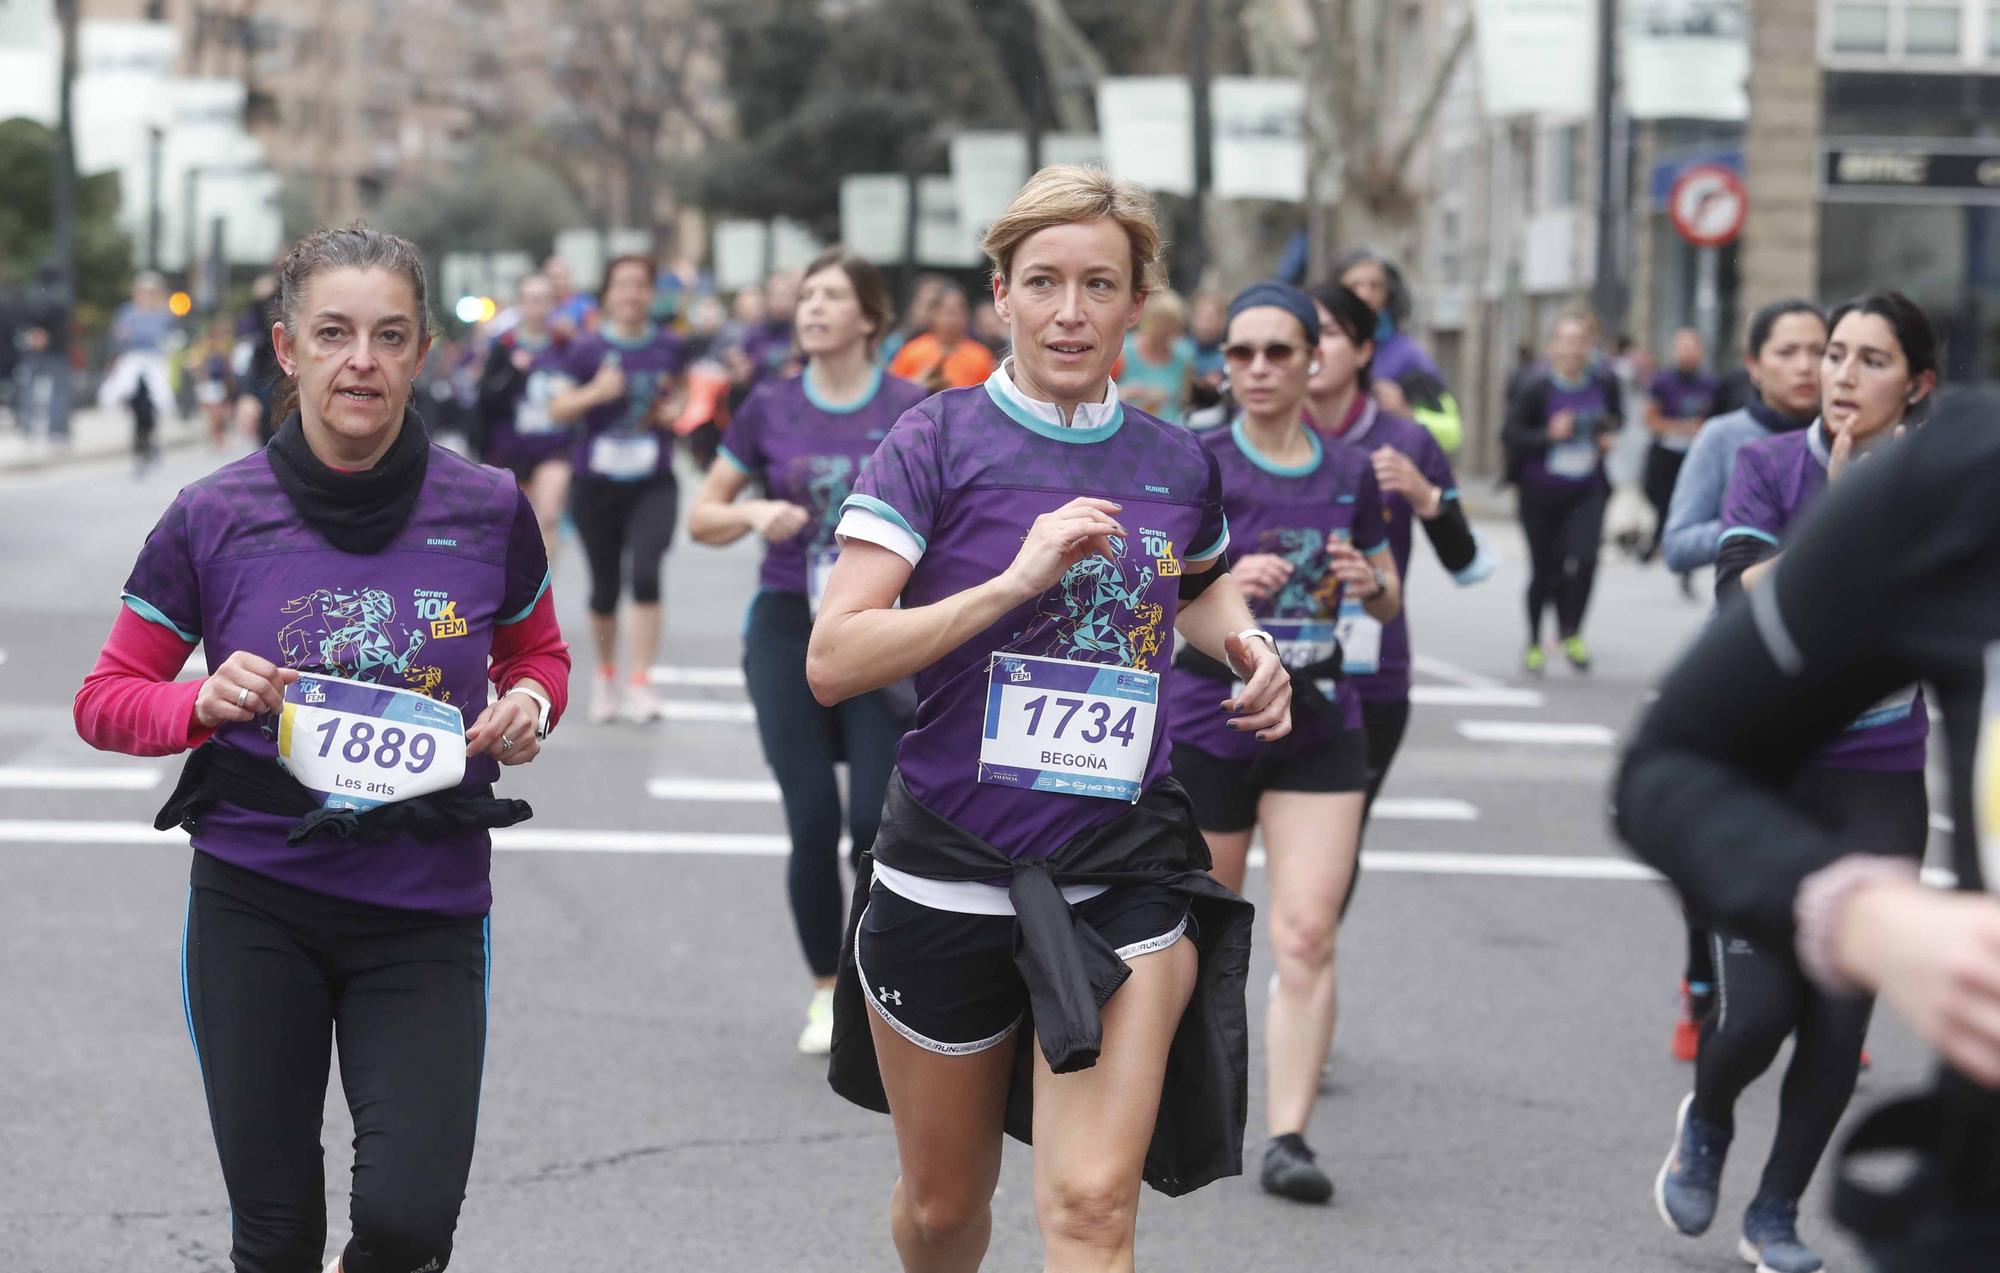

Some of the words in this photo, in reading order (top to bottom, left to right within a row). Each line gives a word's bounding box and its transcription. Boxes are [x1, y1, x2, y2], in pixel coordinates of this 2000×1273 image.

[1141, 536, 1173, 560] 10K
[1159, 561, 1180, 574] FEM
[413, 588, 448, 599] Carrera
[413, 598, 457, 621] 10K
[434, 620, 465, 637] FEM
[1012, 673, 1030, 681] FEM
[1117, 674, 1125, 685] 6
[306, 694, 325, 702] FEM
[415, 702, 424, 711] 6
[1023, 694, 1137, 747] 1734
[316, 717, 437, 774] 1889
[1040, 750, 1108, 770] BEGOÑA
[335, 774, 362, 790] Les
[366, 780, 395, 796] arts
[1140, 941, 1158, 951] RUN
[875, 1004, 892, 1021] RUN
[935, 1044, 956, 1053] RUN
